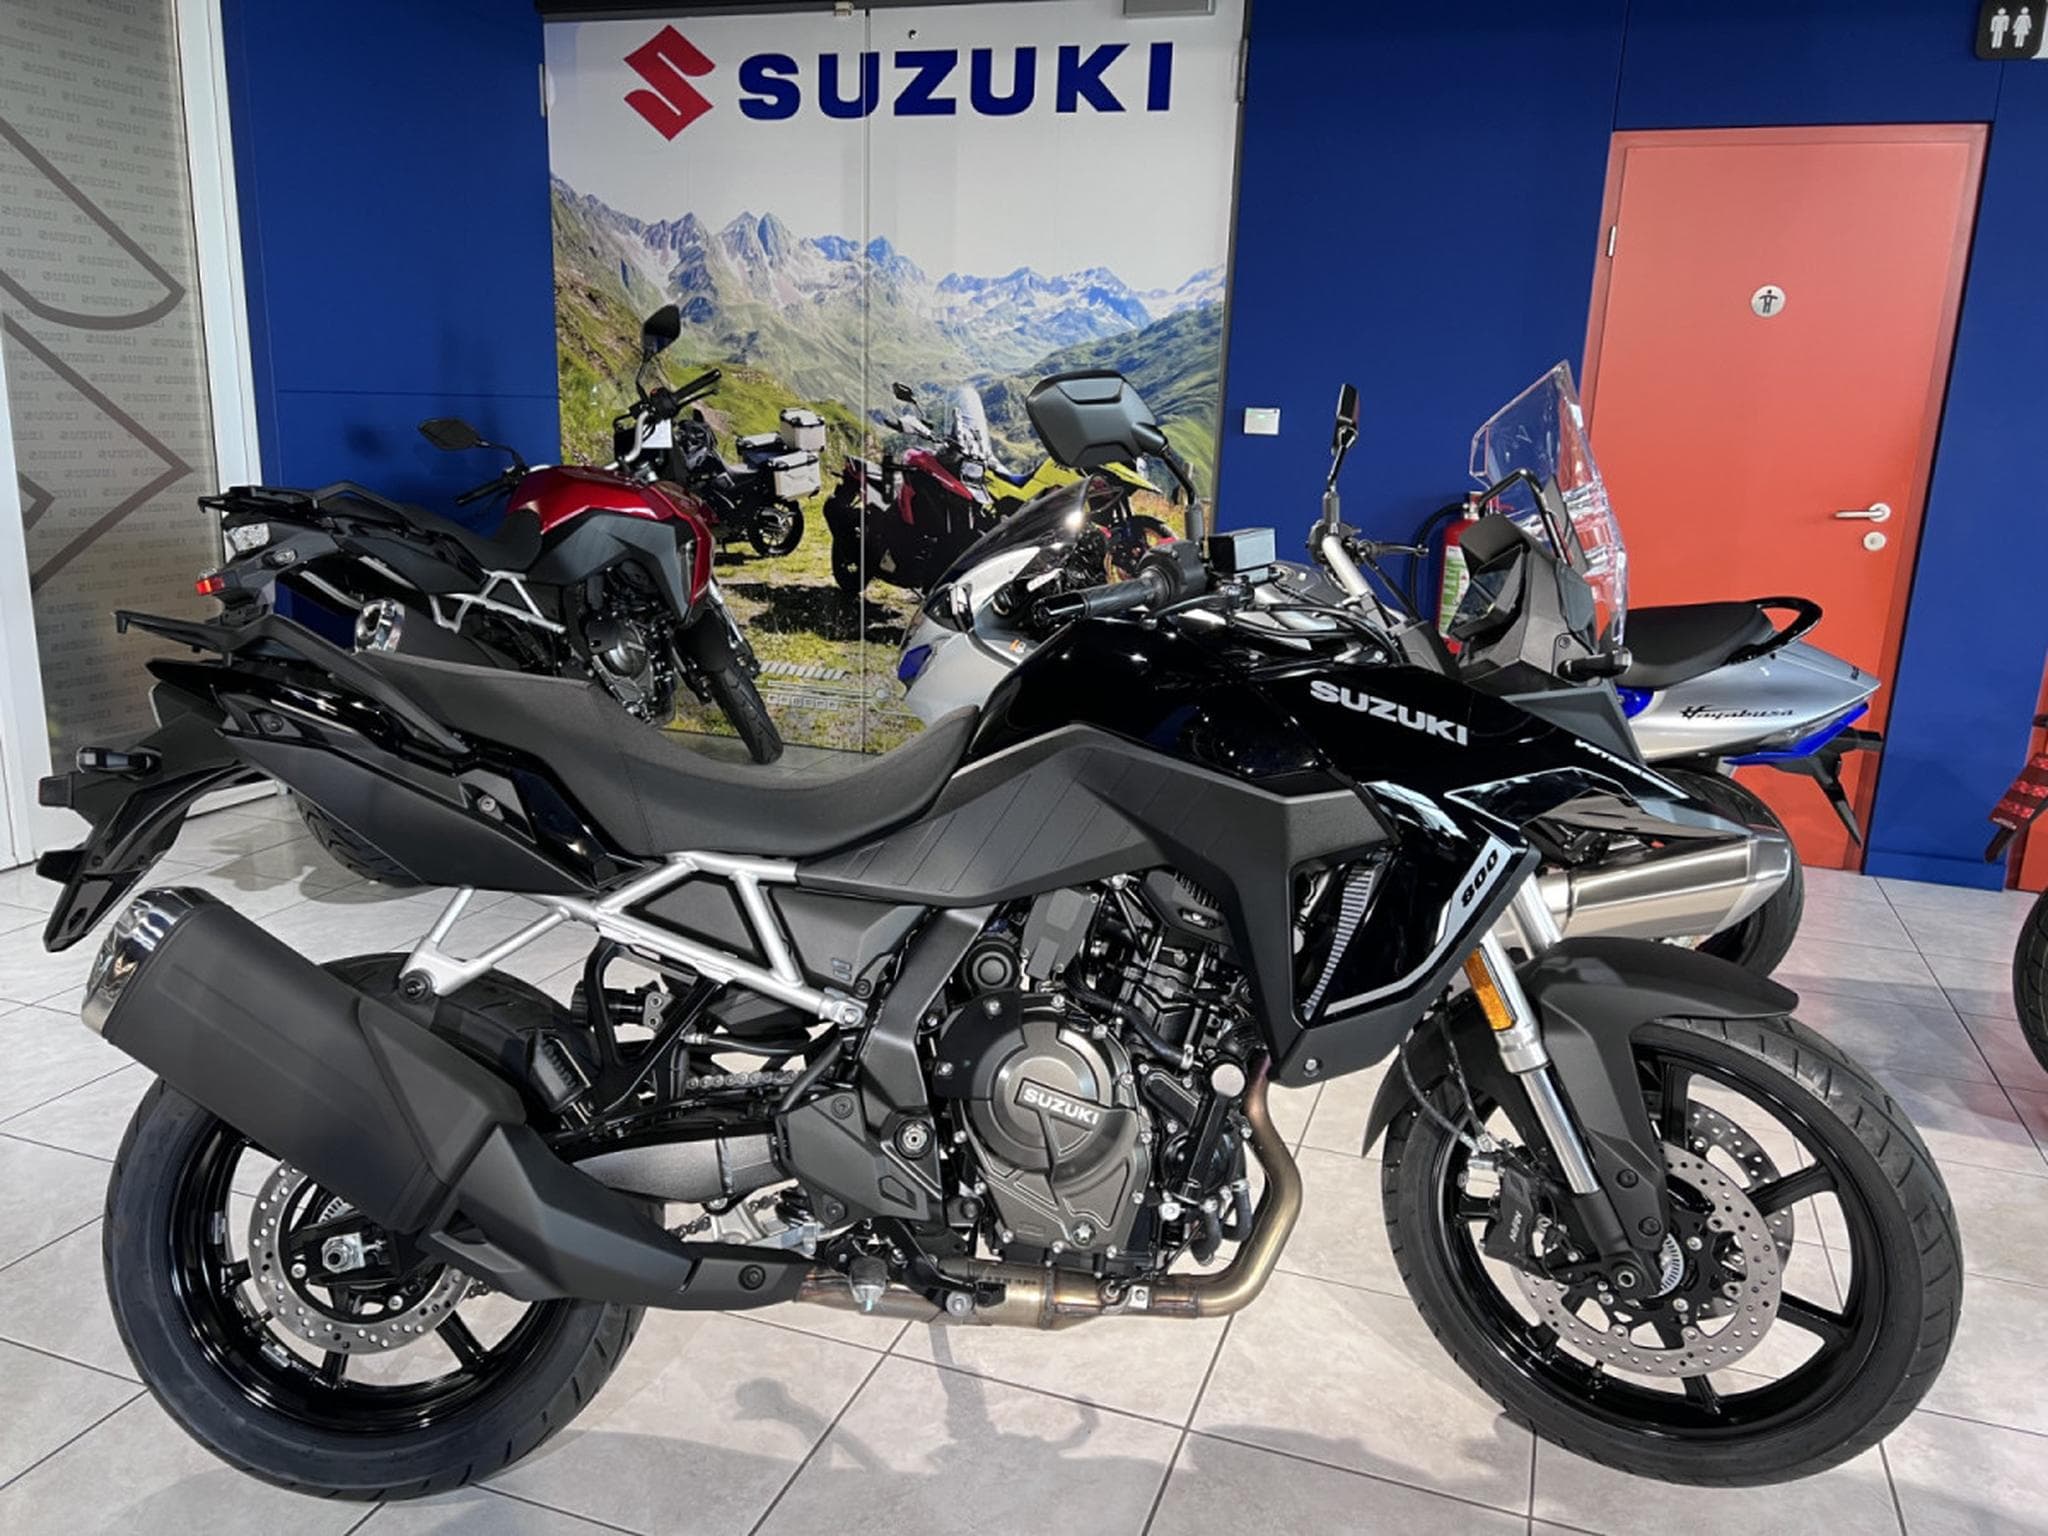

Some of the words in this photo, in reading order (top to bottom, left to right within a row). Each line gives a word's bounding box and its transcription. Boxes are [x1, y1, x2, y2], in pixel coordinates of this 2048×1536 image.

[738, 41, 1173, 121] SUZUKI
[1309, 679, 1469, 746] SUZUKI
[1461, 849, 1498, 908] 800
[1023, 1087, 1100, 1125] SUZUKI
